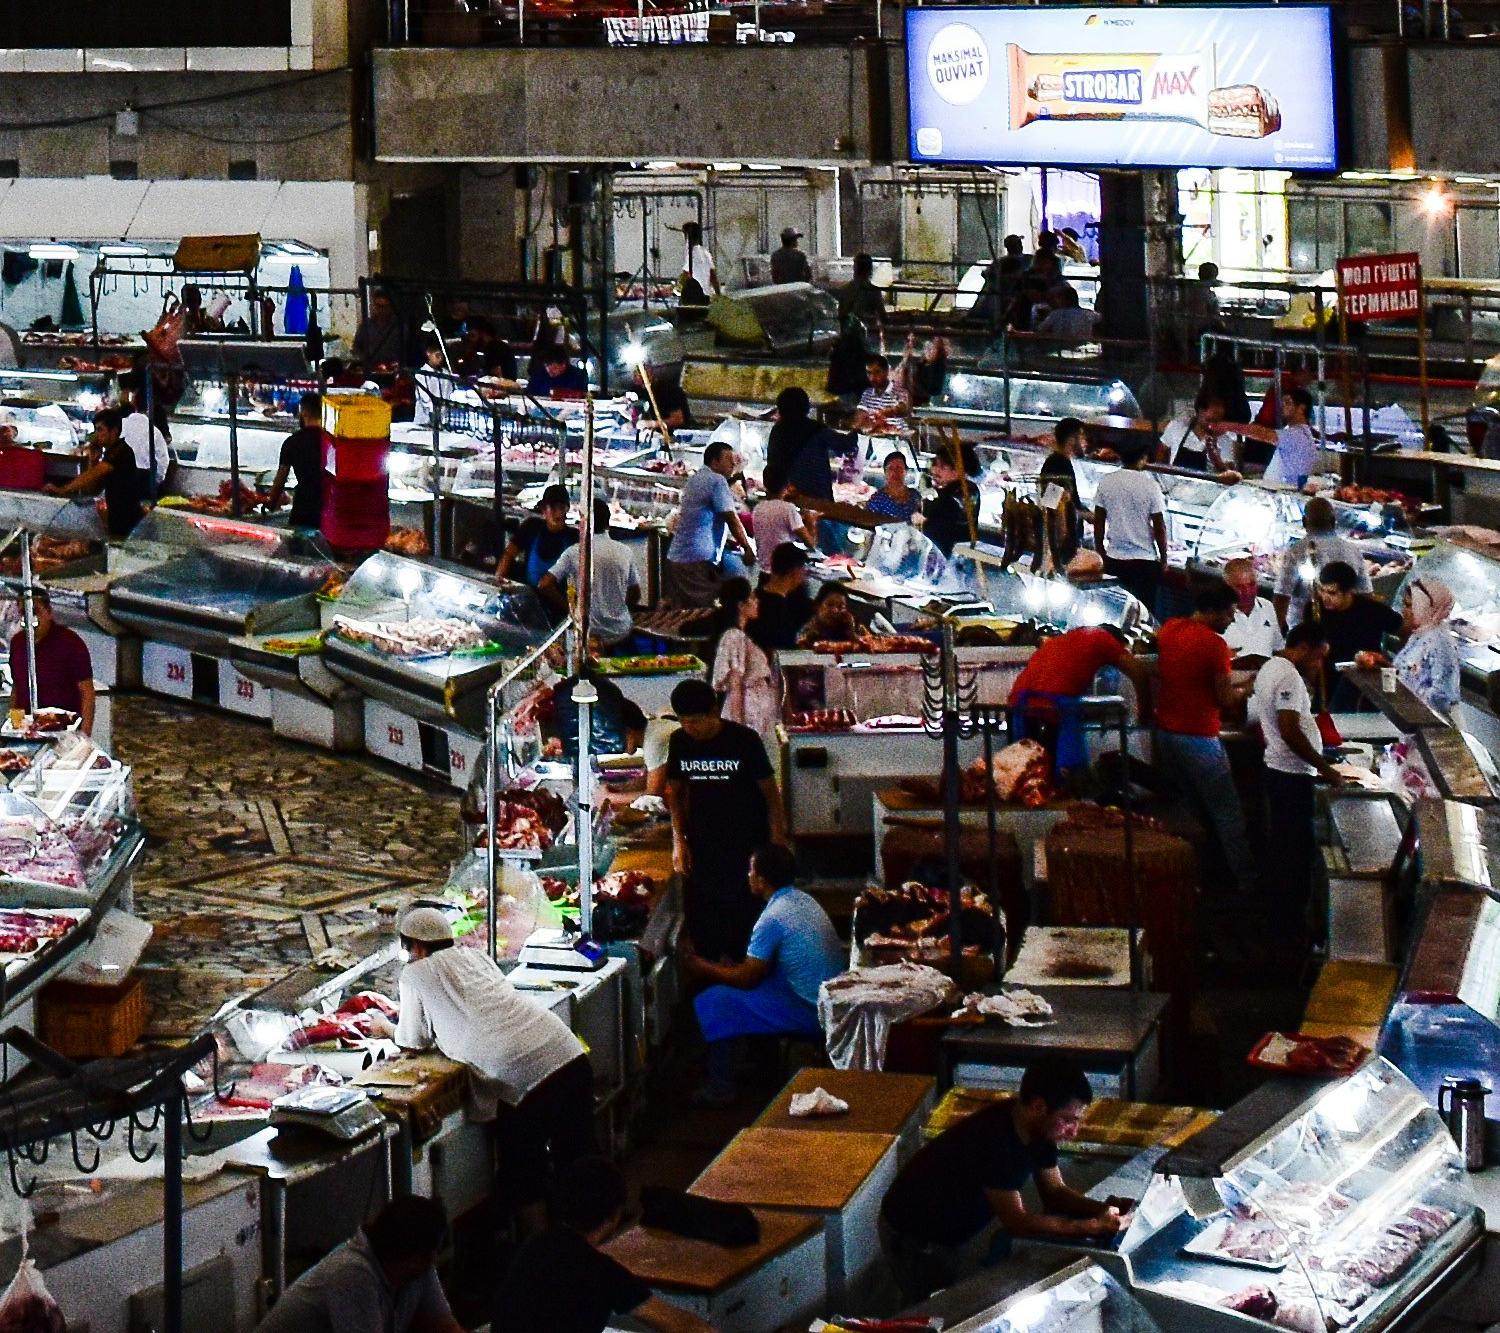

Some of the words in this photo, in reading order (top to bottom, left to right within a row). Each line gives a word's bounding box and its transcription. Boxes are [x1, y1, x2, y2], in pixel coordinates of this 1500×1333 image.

[933, 46, 983, 66] MAKSIMAL
[935, 61, 985, 83] QUVVAT
[1064, 72, 1141, 101] STROBAR
[1151, 65, 1200, 100] MAX
[1343, 290, 1418, 314] ТЕРМИНАЛ
